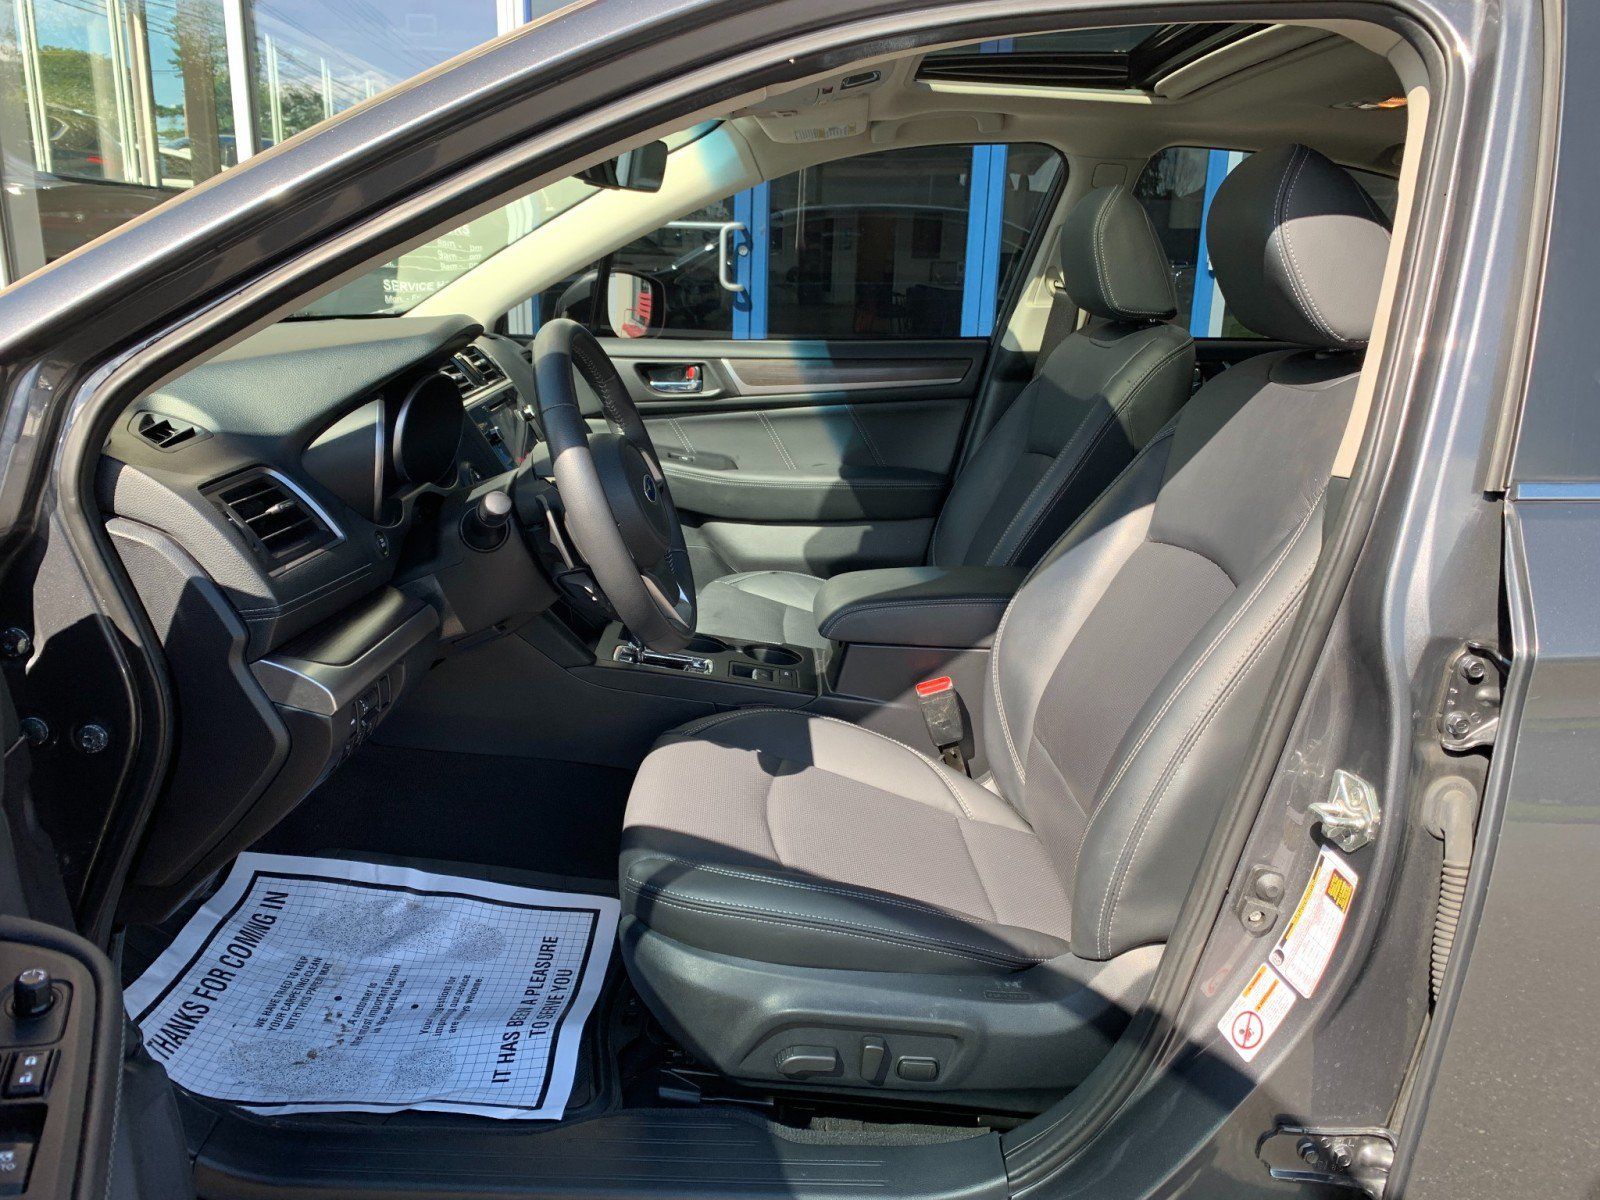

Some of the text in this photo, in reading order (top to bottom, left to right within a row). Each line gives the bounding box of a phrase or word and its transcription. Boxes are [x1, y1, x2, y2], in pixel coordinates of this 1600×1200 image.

[383, 279, 434, 292] SERVICE
[147, 891, 289, 1060] THANKS FOR COMING IN
[525, 936, 558, 996] PLEASURE
[254, 1017, 268, 1027] WE
[262, 999, 280, 1016] HAVE
[274, 981, 293, 997] TRIED
[293, 955, 308, 971] KEEP
[267, 957, 322, 1031] YOUR CARPETING CLEAN
[352, 989, 373, 1018] customer
[366, 986, 390, 1017] important
[384, 964, 401, 985] person
[383, 997, 398, 1014] world
[419, 1018, 434, 1034] Your
[446, 976, 456, 984] for
[450, 997, 460, 1007] our
[455, 974, 471, 995] service
[529, 969, 573, 1038] TO SERVE YOU
[284, 1012, 302, 1029] WITH
[296, 996, 312, 1010] THIS
[448, 1021, 459, 1033] are
[506, 1006, 533, 1027] BEEN
[497, 1032, 520, 1063] HAS
[492, 1070, 511, 1083] IT
